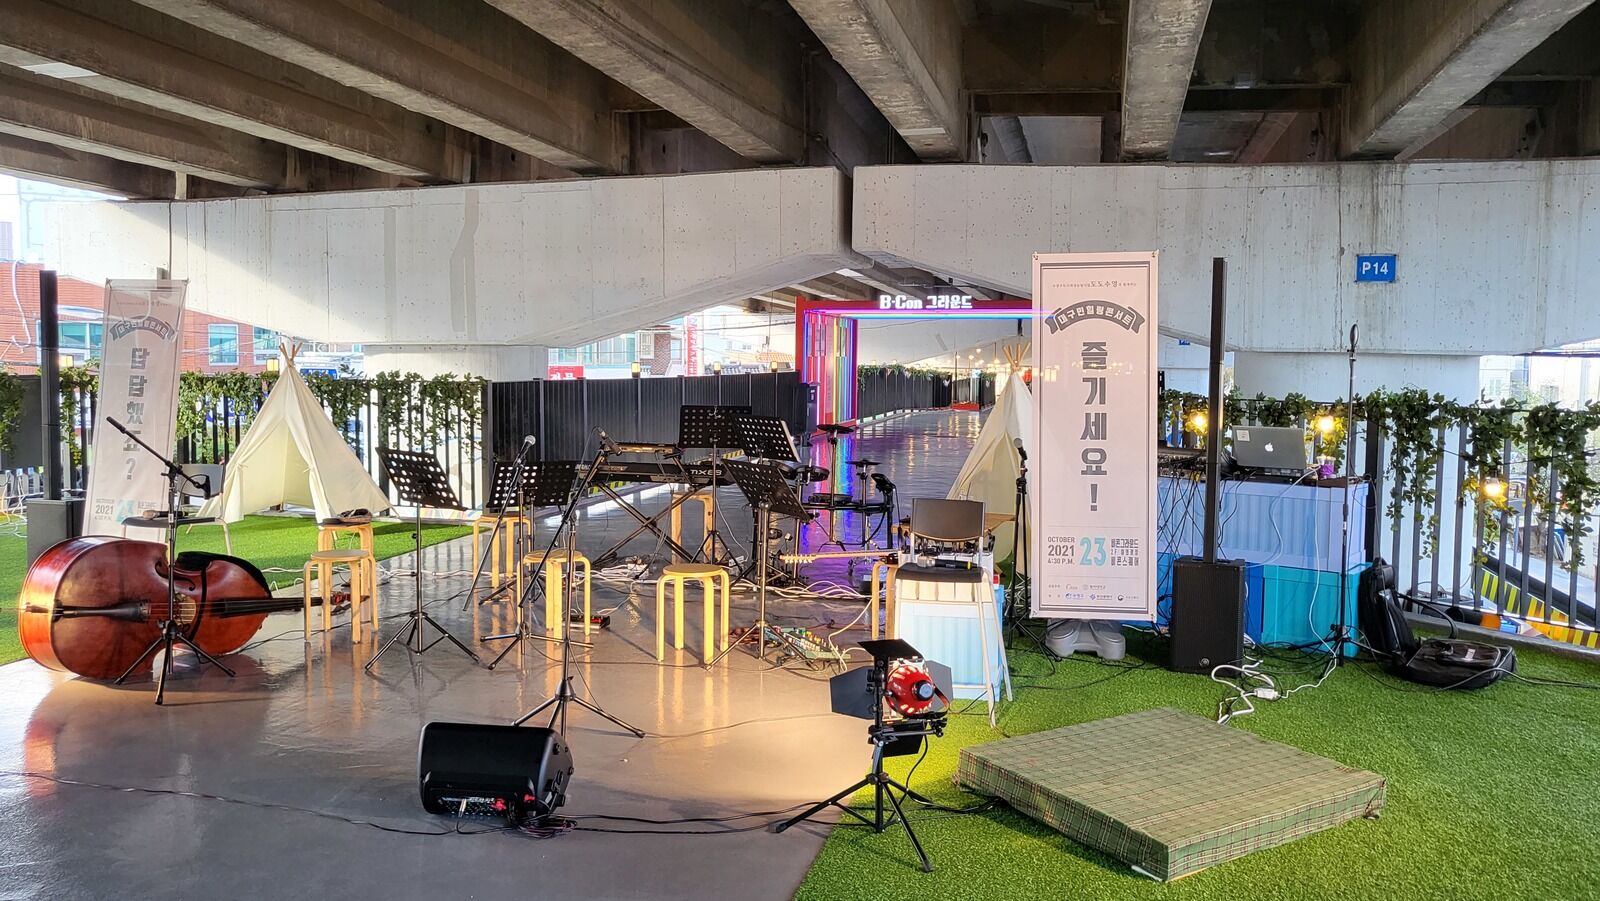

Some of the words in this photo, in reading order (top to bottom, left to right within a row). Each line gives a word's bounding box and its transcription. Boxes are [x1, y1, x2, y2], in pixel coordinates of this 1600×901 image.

[1362, 262, 1389, 275] P14
[926, 294, 973, 309] 그라운드
[1080, 341, 1108, 512] 즐기세요!
[95, 504, 114, 515] 2021
[1047, 544, 1075, 557] 2021
[1079, 536, 1107, 566] 23
